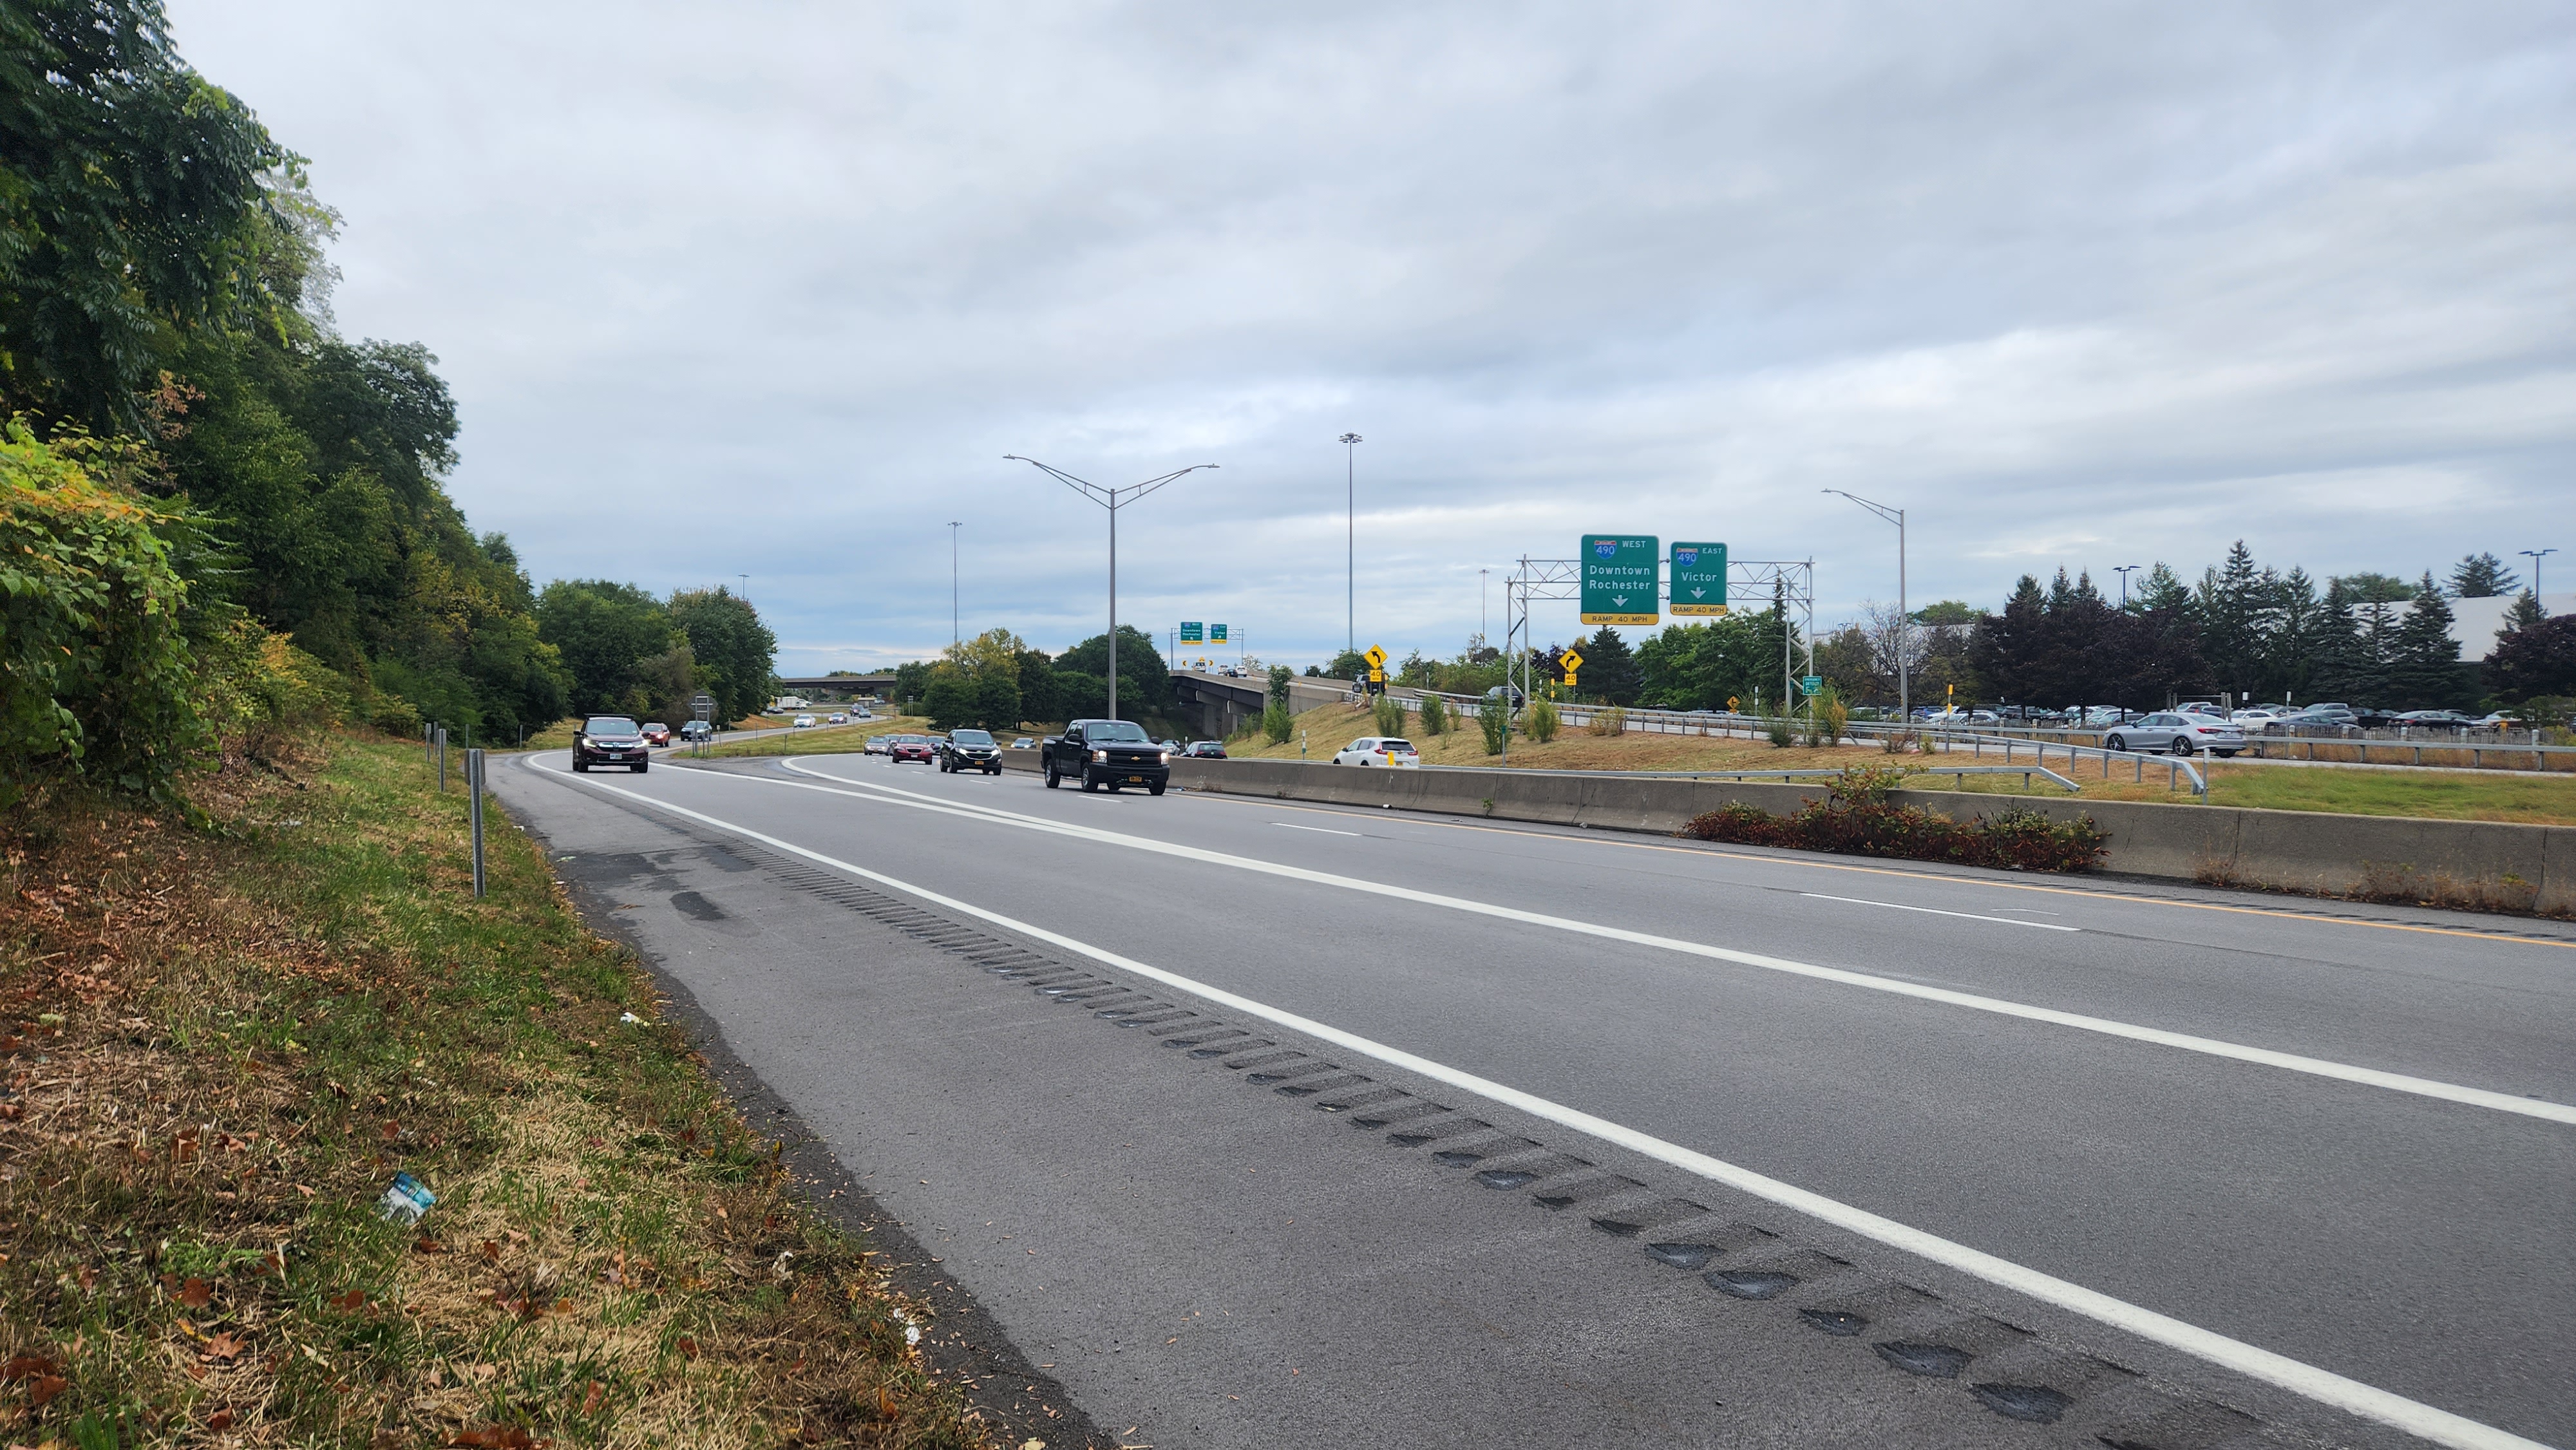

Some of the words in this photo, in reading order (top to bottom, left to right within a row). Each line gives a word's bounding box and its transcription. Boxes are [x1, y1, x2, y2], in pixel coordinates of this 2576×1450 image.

[1596, 545, 1615, 554] 490
[1678, 553, 1696, 561] 490
[1590, 565, 1650, 575] Downtown
[1681, 572, 1717, 581] Victor
[1589, 580, 1650, 589] Rochester
